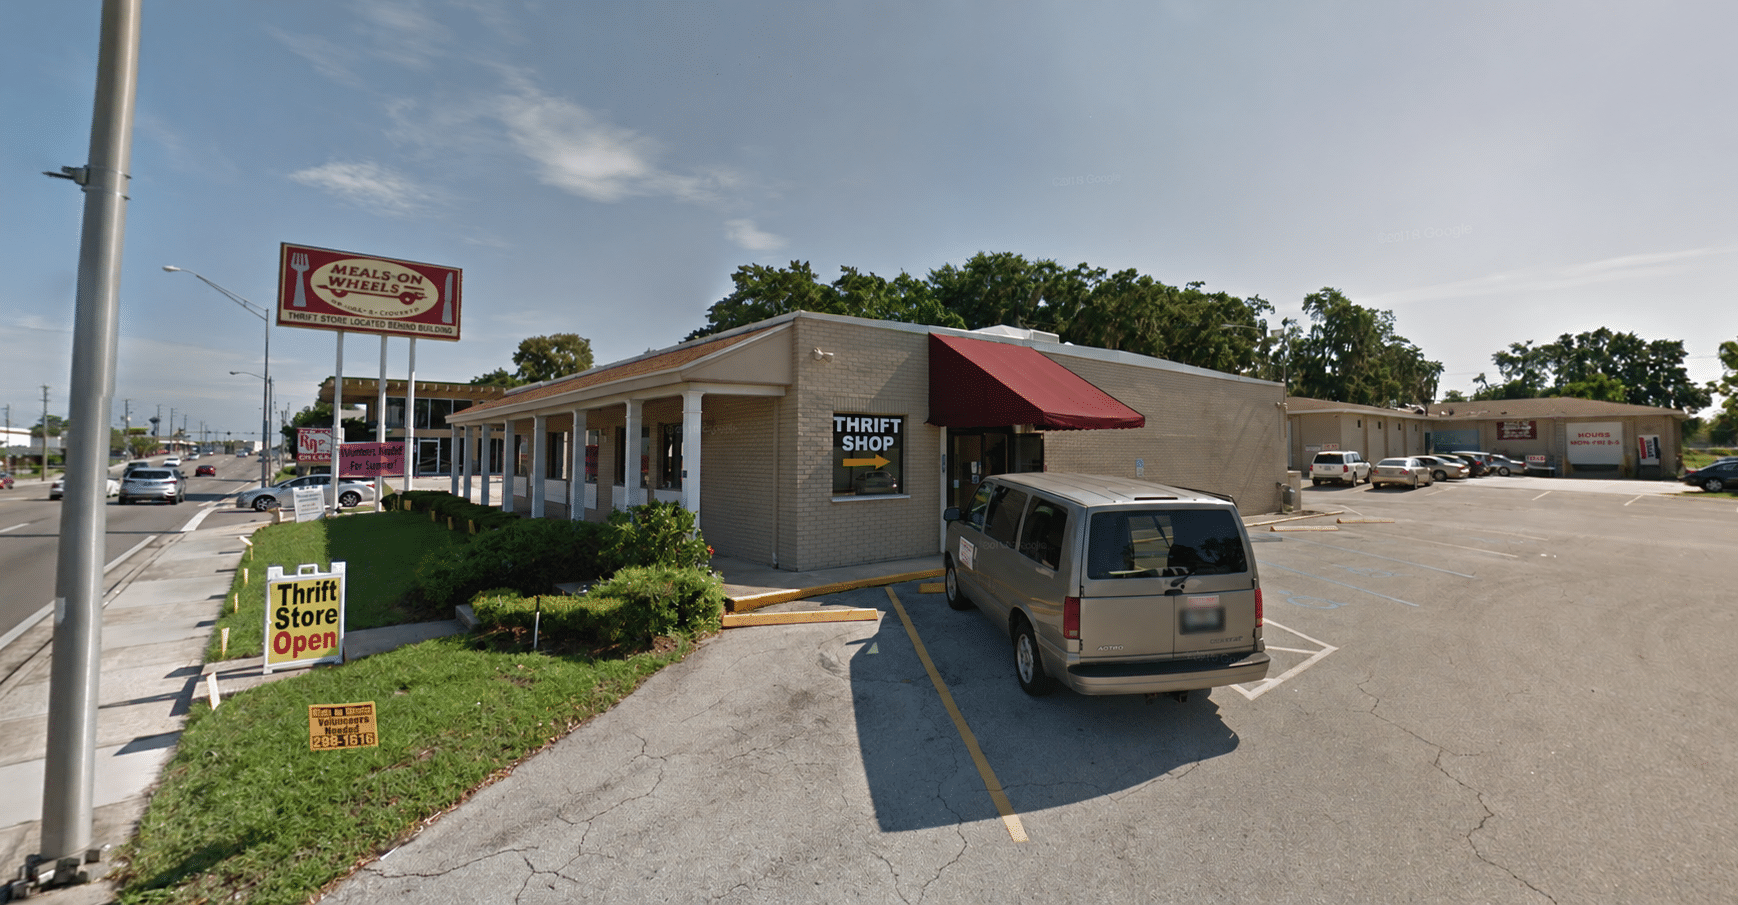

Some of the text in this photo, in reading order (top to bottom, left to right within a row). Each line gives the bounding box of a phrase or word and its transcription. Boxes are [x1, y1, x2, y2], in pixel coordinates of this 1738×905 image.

[328, 276, 400, 294] WHEELS
[288, 312, 453, 334] THRIFT STORE LOCATED BEHIND BUILDING
[833, 416, 901, 433] THRIFT
[842, 435, 894, 451] SHOP
[277, 580, 337, 606] Thrift
[275, 607, 338, 630] Store
[273, 631, 336, 658] Open
